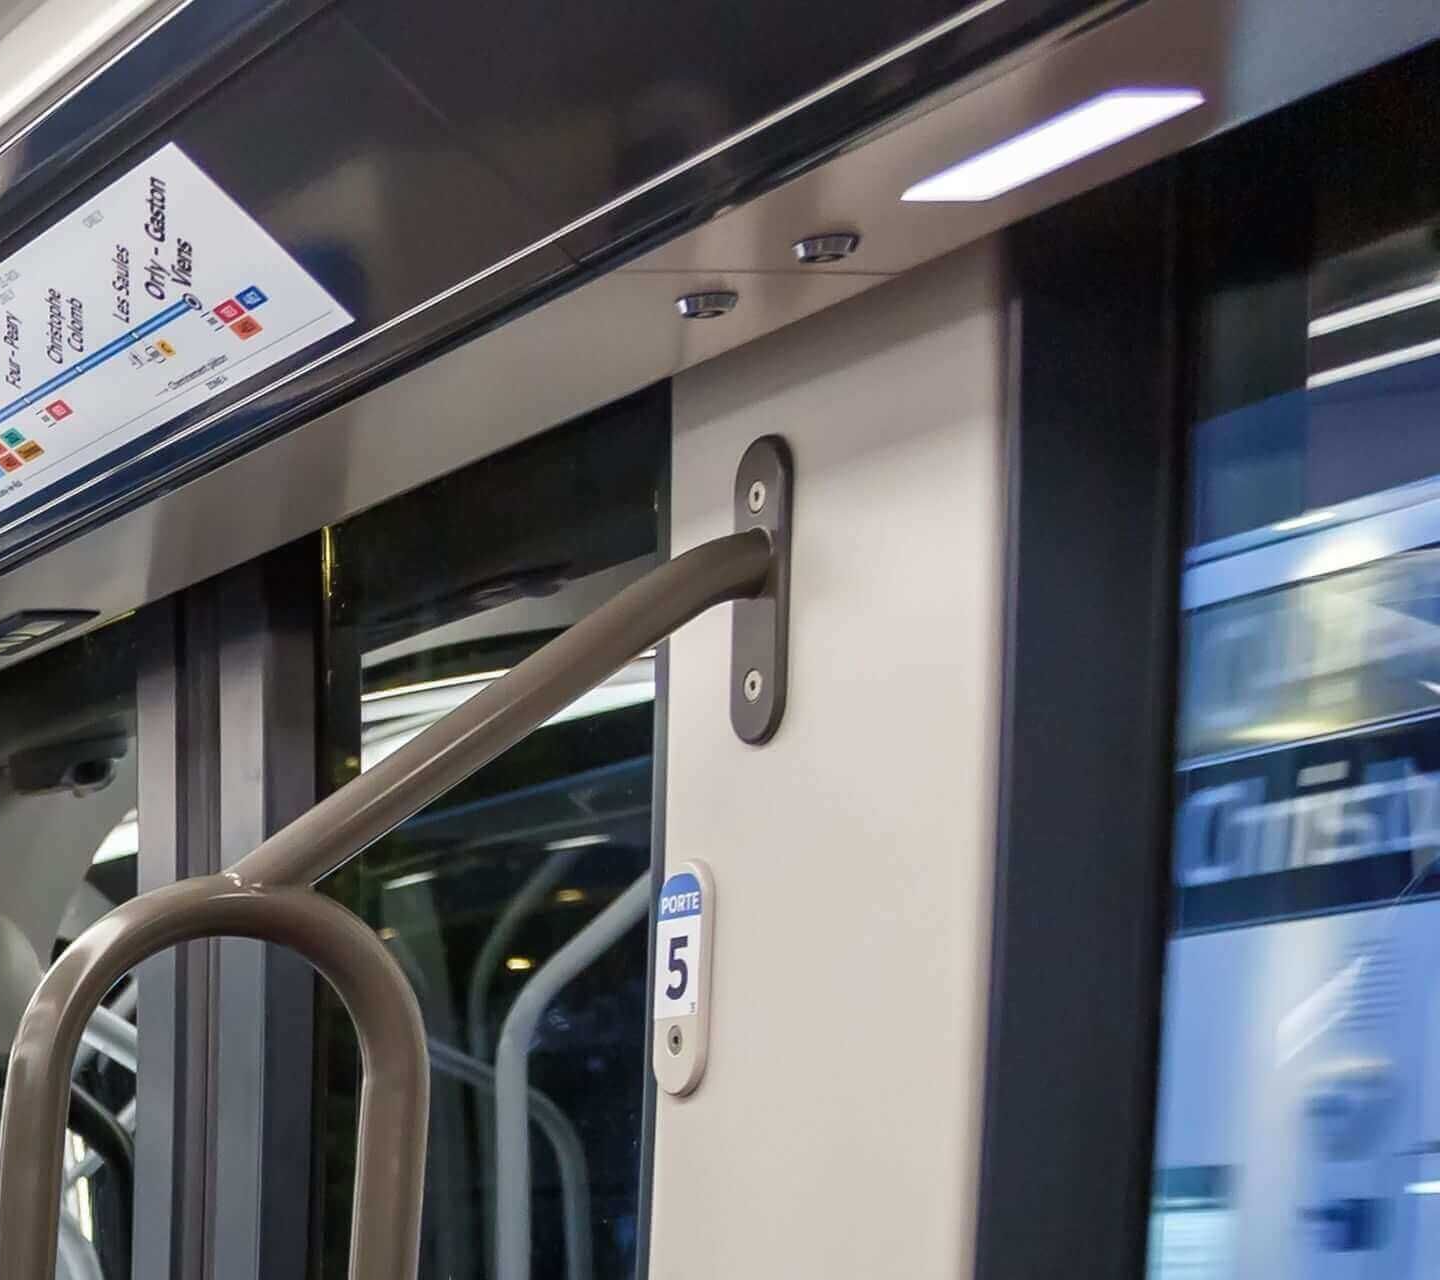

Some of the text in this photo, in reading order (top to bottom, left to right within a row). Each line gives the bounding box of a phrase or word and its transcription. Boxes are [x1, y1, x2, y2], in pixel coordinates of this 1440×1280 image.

[144, 176, 166, 242] Gaston
[112, 245, 130, 323] Les Saules
[144, 259, 171, 300] Orly
[171, 238, 193, 287] Viens
[4, 311, 22, 350] Peary
[44, 288, 66, 365] Christophe
[67, 297, 84, 353] Colomb
[5, 358, 21, 389] Four
[660, 891, 700, 915] PORTE
[665, 935, 689, 1001] 5
